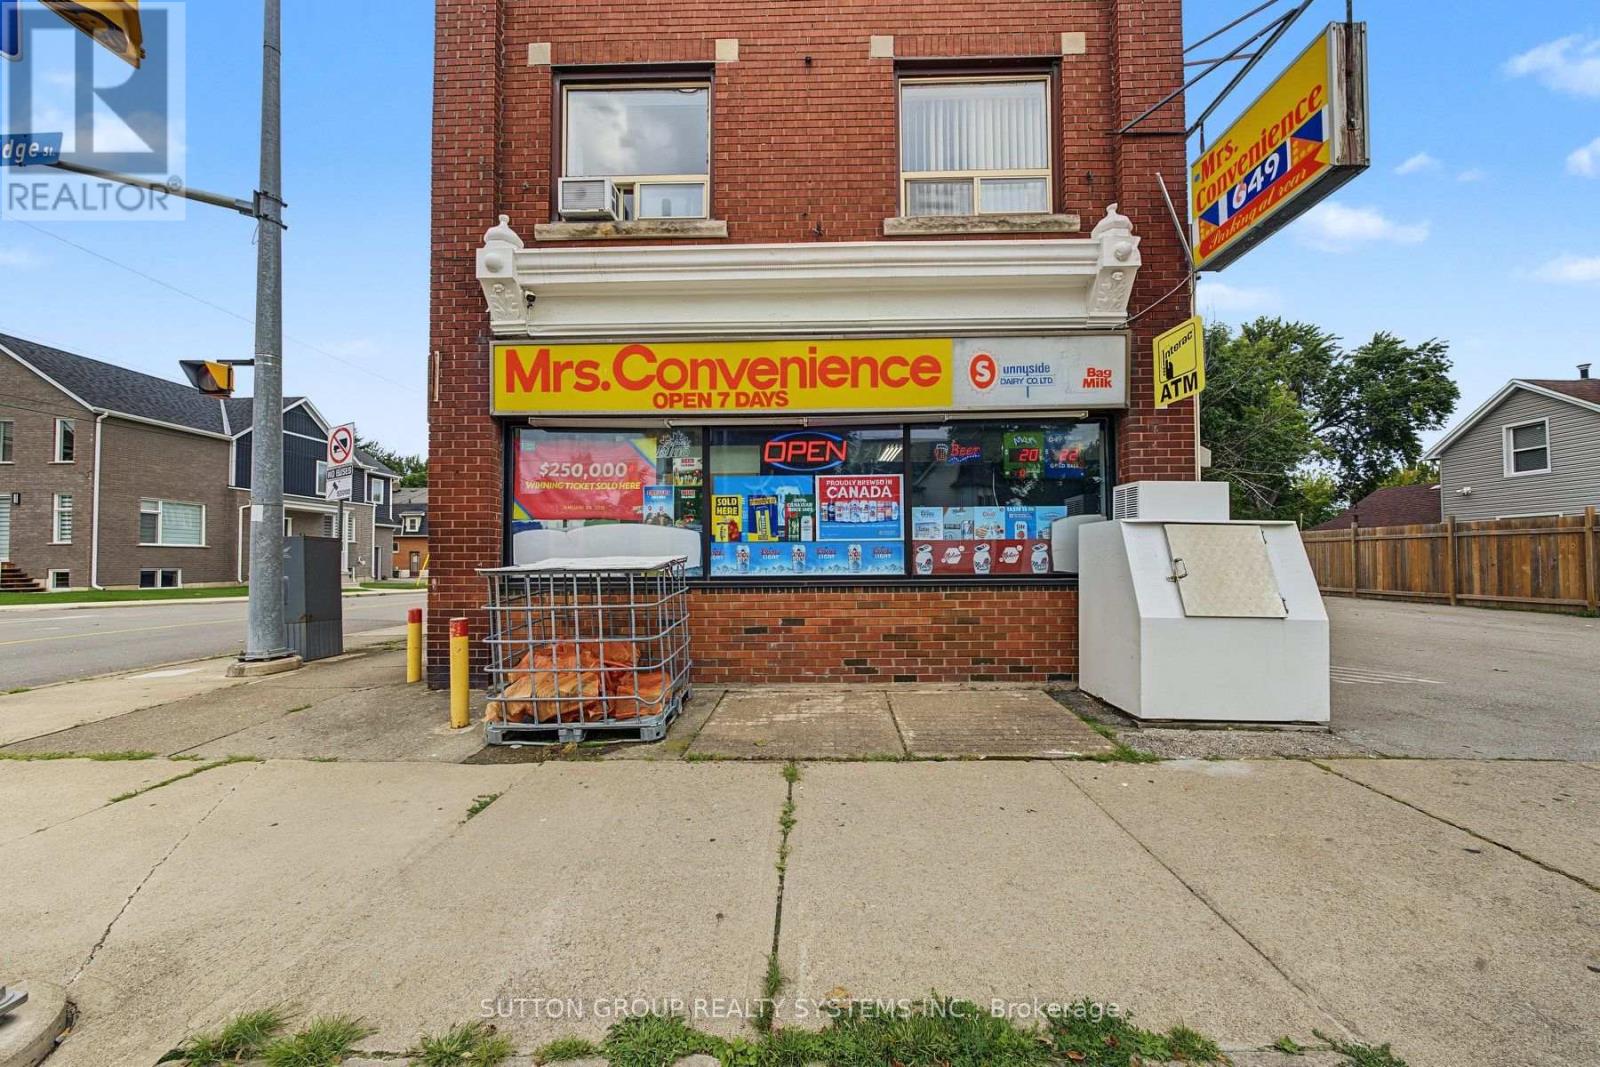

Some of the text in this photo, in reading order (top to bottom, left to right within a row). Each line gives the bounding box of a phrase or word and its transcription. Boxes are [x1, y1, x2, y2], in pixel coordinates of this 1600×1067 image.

[1196, 83, 1323, 213] Convenience
[1200, 138, 1238, 185] Mrs.
[505, 344, 942, 393] Mrs. Convenience
[1086, 367, 1112, 379] Bag
[1000, 377, 1024, 386] DAIRY
[1082, 377, 1112, 389] Milk
[1160, 371, 1198, 403] ATM
[652, 390, 789, 410] OPEN 7 DAYS
[764, 440, 846, 463] OPEN
[950, 440, 981, 457] Beer
[539, 462, 628, 480] $250,000
[526, 481, 563, 490] WINNING
[595, 481, 618, 490] SOLD
[619, 481, 641, 490] HERE
[826, 485, 893, 499] CANADA
[716, 497, 737, 506] SOLD
[716, 506, 738, 515] HERE
